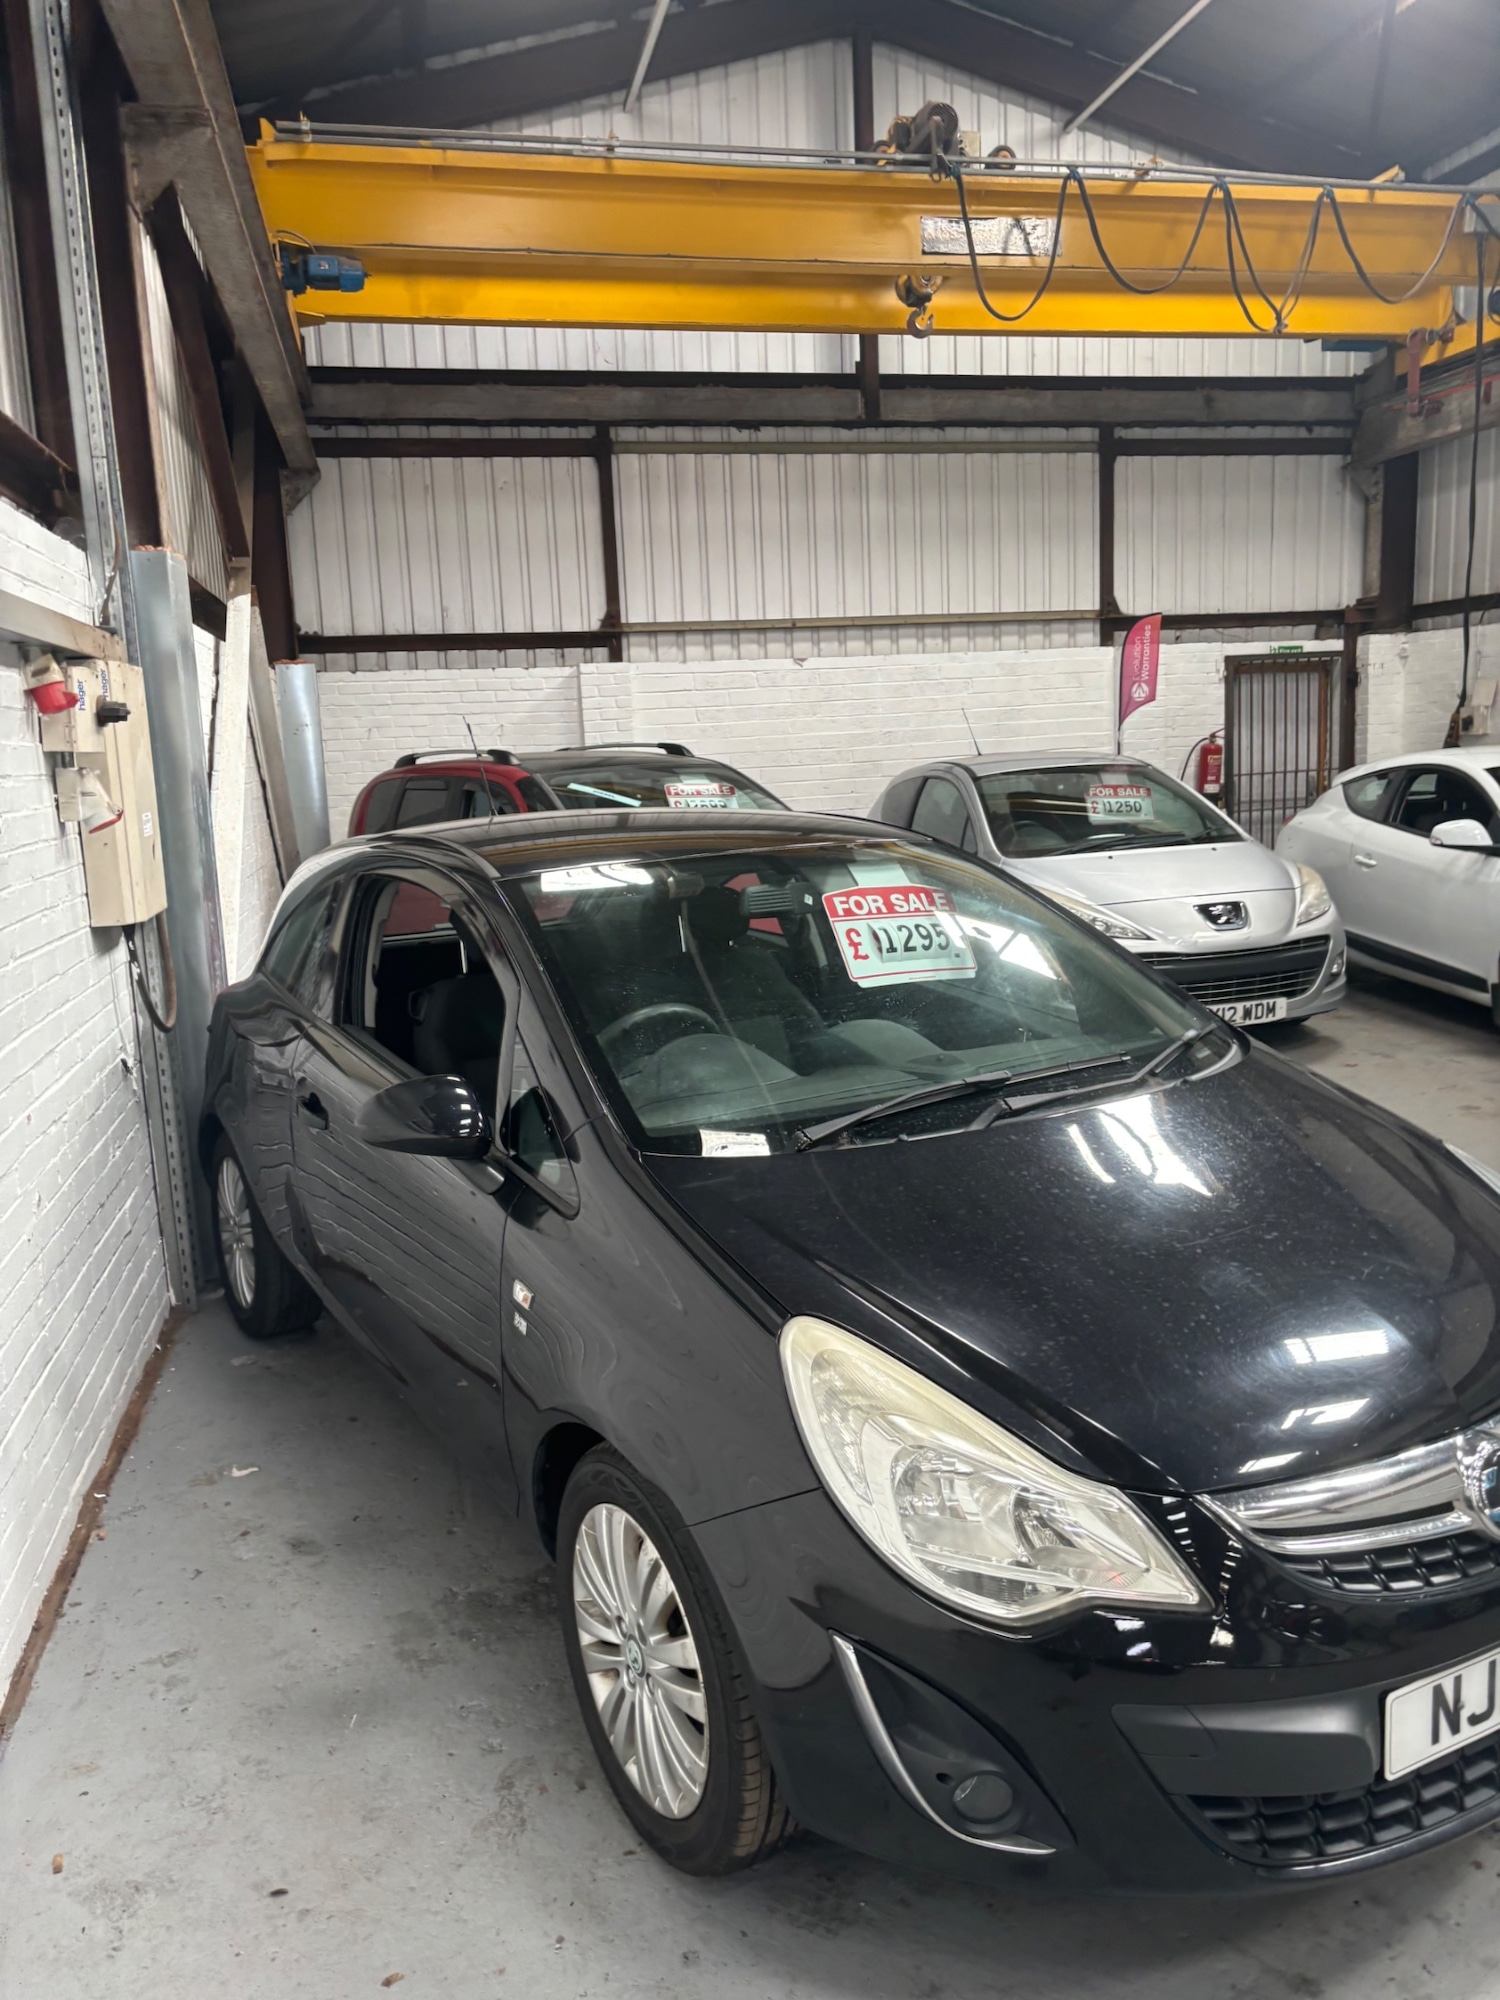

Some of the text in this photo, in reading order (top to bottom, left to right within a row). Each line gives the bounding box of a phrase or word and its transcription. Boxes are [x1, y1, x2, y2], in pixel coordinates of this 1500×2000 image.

[1133, 636, 1141, 680] Evolution
[1142, 624, 1151, 681] Warranties
[77, 679, 86, 711] hager
[669, 786, 731, 795] FOR SALE
[1089, 787, 1147, 797] FOR SALE
[832, 892, 950, 916] FOR SALE
[1243, 1001, 1276, 1021] WDM
[1431, 1658, 1497, 1747] NJ
